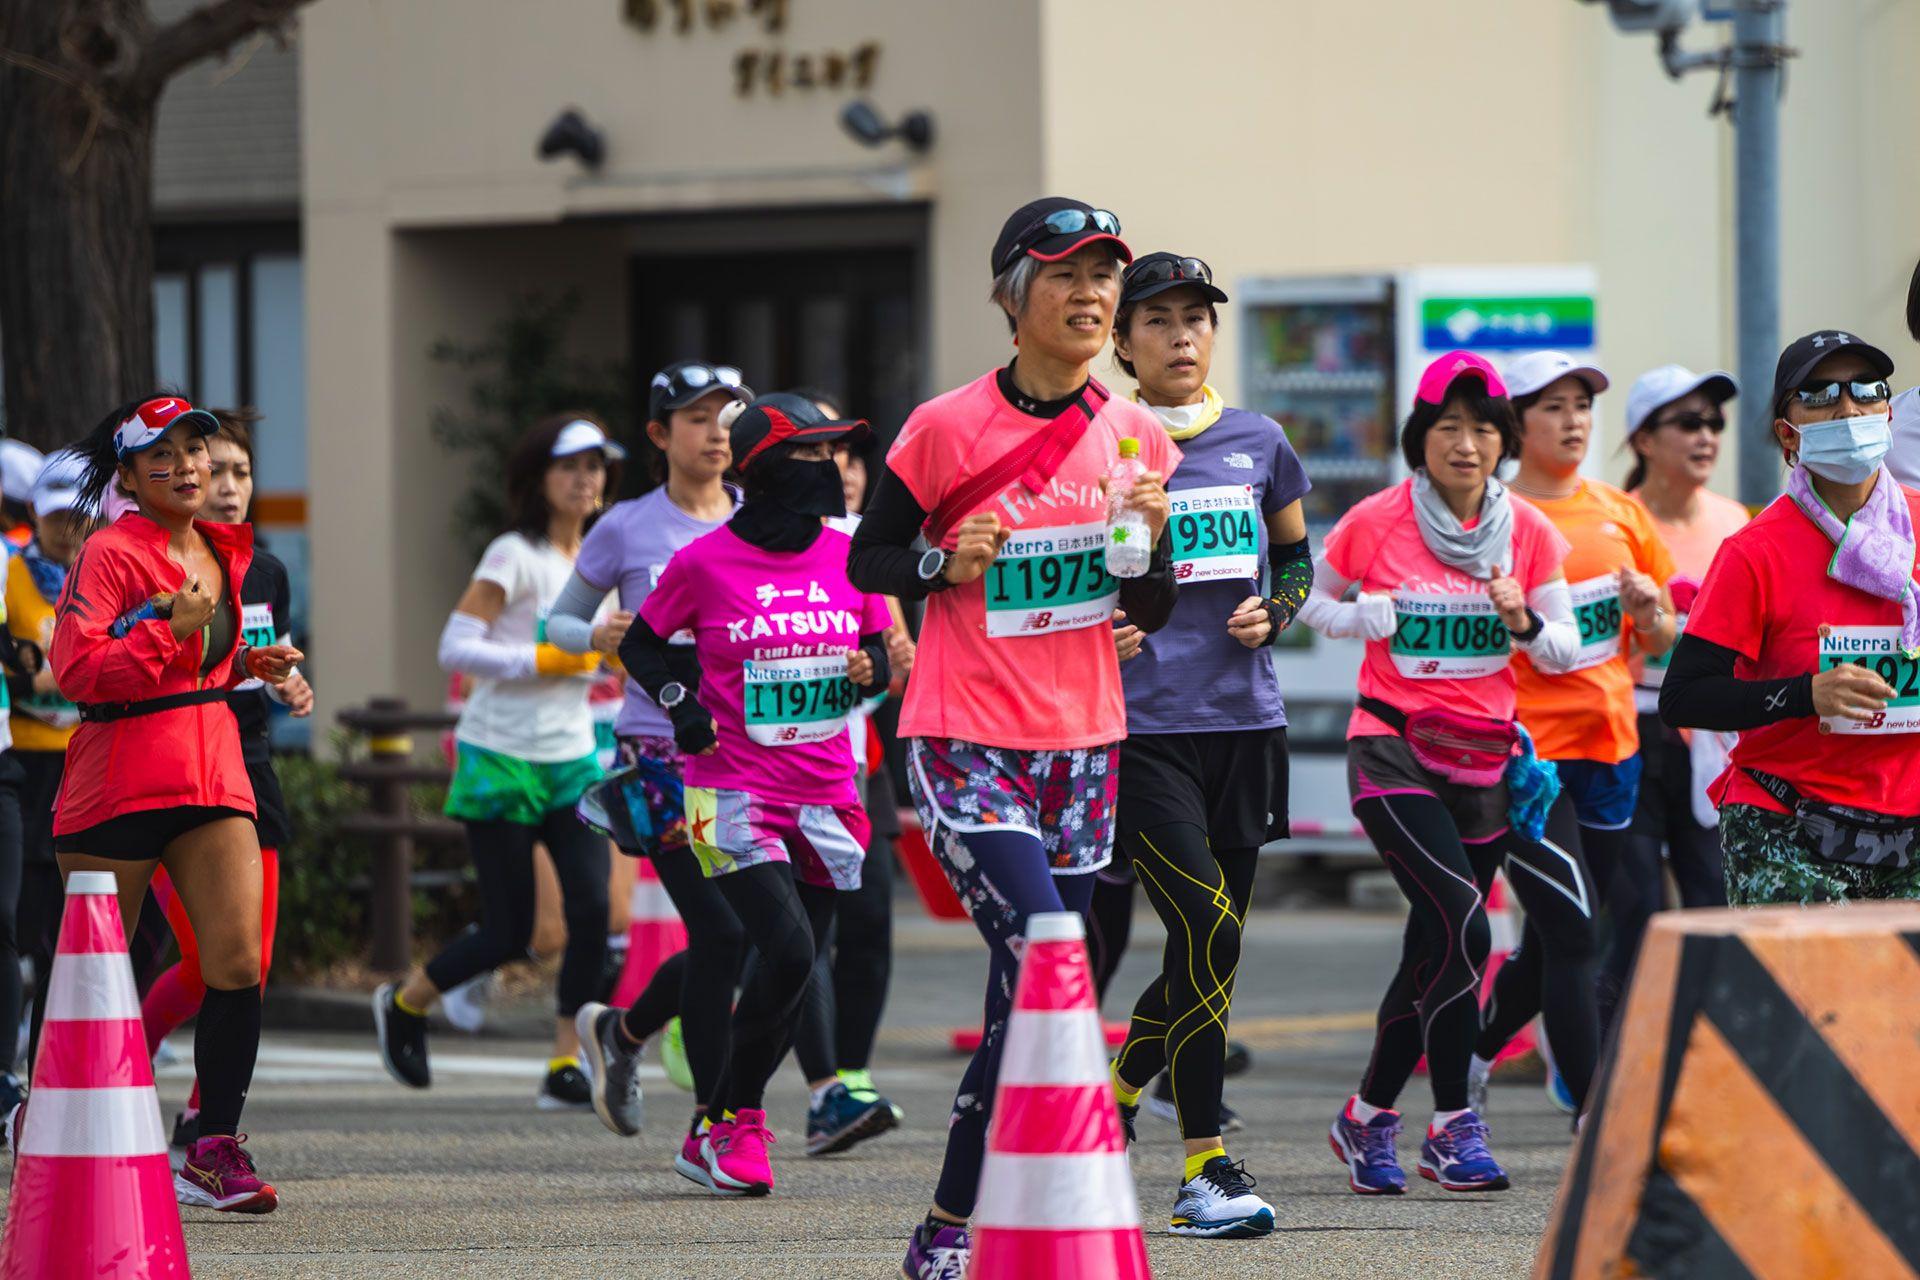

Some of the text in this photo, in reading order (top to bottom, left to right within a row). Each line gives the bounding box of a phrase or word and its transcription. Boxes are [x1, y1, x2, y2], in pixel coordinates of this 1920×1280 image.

[1001, 540, 1053, 555] iterra
[992, 549, 1112, 602] I1975
[755, 580, 831, 608] チーム
[1392, 615, 1508, 651] K21086
[1824, 635, 1891, 651] Niterra
[747, 668, 801, 681] Niterra
[751, 678, 854, 718] I19748
[1886, 721, 1905, 729] new
